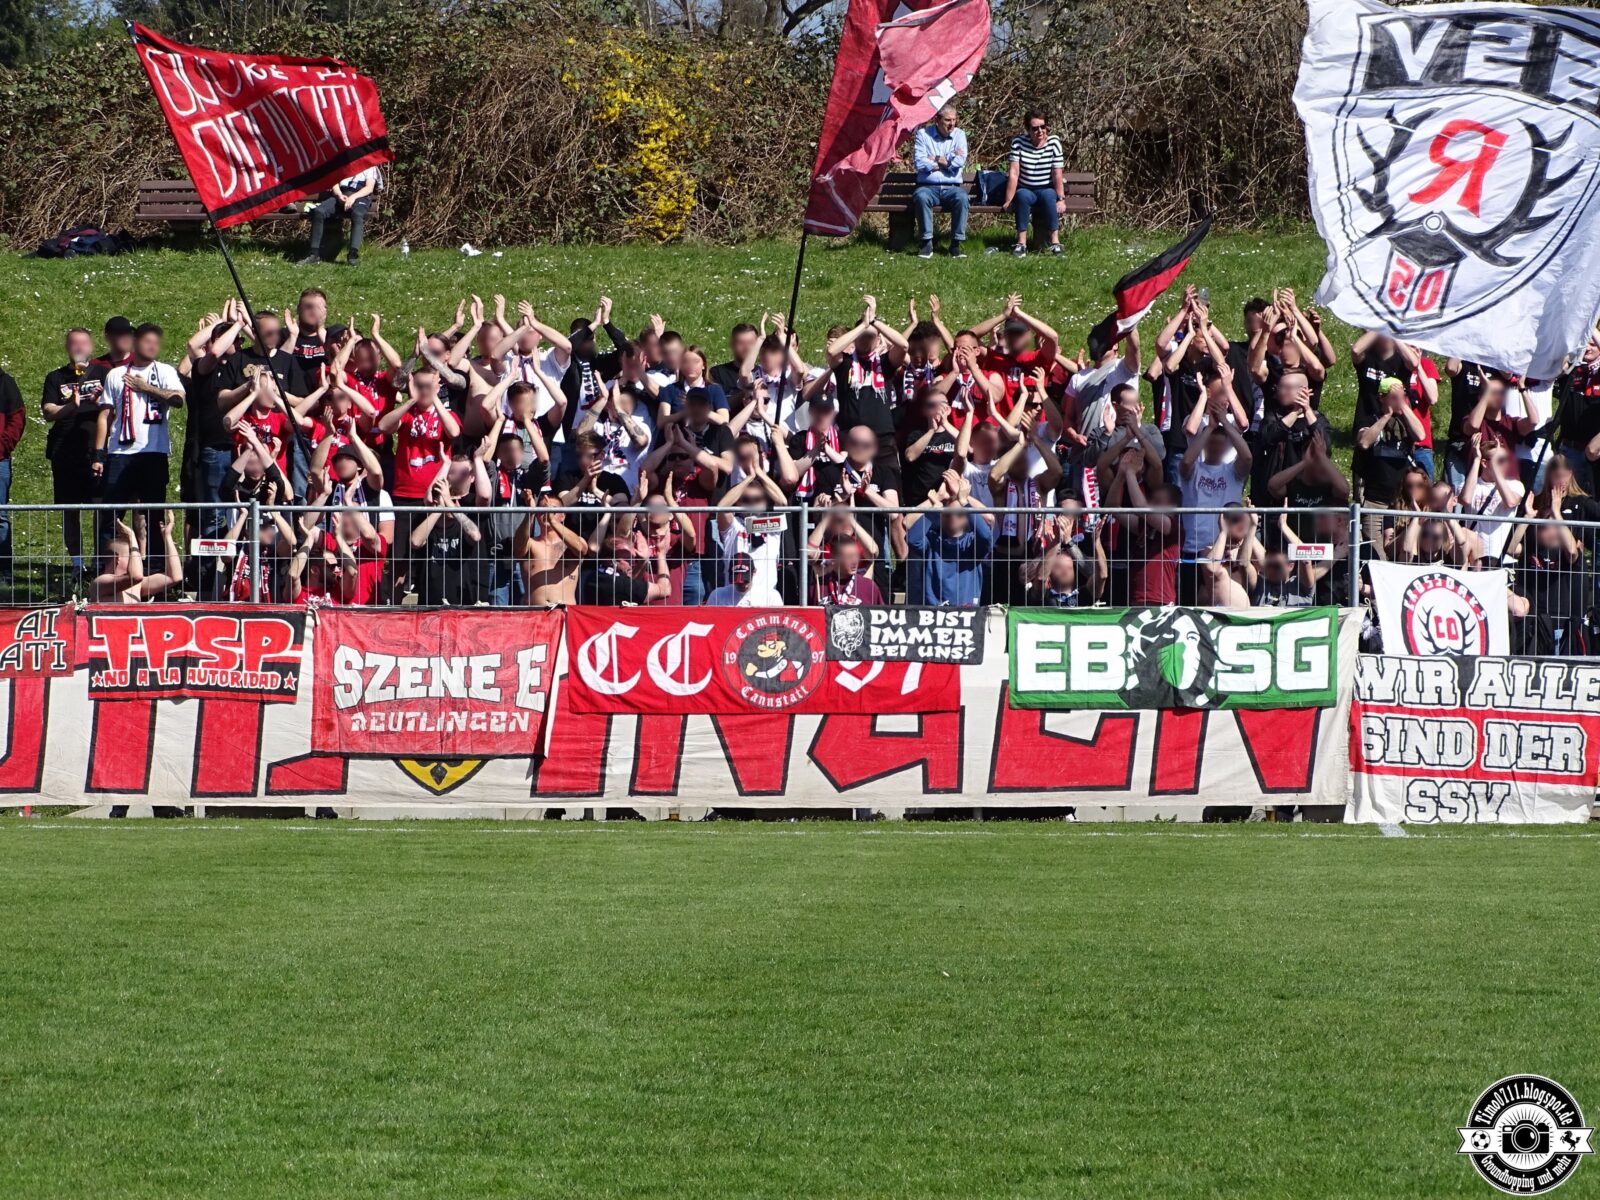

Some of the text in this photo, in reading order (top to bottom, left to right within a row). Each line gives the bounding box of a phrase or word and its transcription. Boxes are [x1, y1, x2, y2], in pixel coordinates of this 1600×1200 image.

[14, 608, 60, 640] AI
[735, 615, 815, 640] Commando
[869, 609, 977, 627] DU BIST
[92, 615, 295, 672] TPSP
[870, 626, 976, 646] IMMER
[724, 650, 826, 665] 19 97
[869, 644, 976, 660] BEI UNS!
[103, 668, 281, 690] NO A LA AUTORIDAD
[333, 643, 548, 713] SZENE E
[1355, 656, 1600, 714] WIR ALLE
[741, 684, 809, 708] Cannstatt
[350, 711, 529, 732] REUTLINGEN
[1362, 716, 1475, 768] SIND
[1484, 721, 1585, 774] DER
[1405, 778, 1511, 823] SSV
